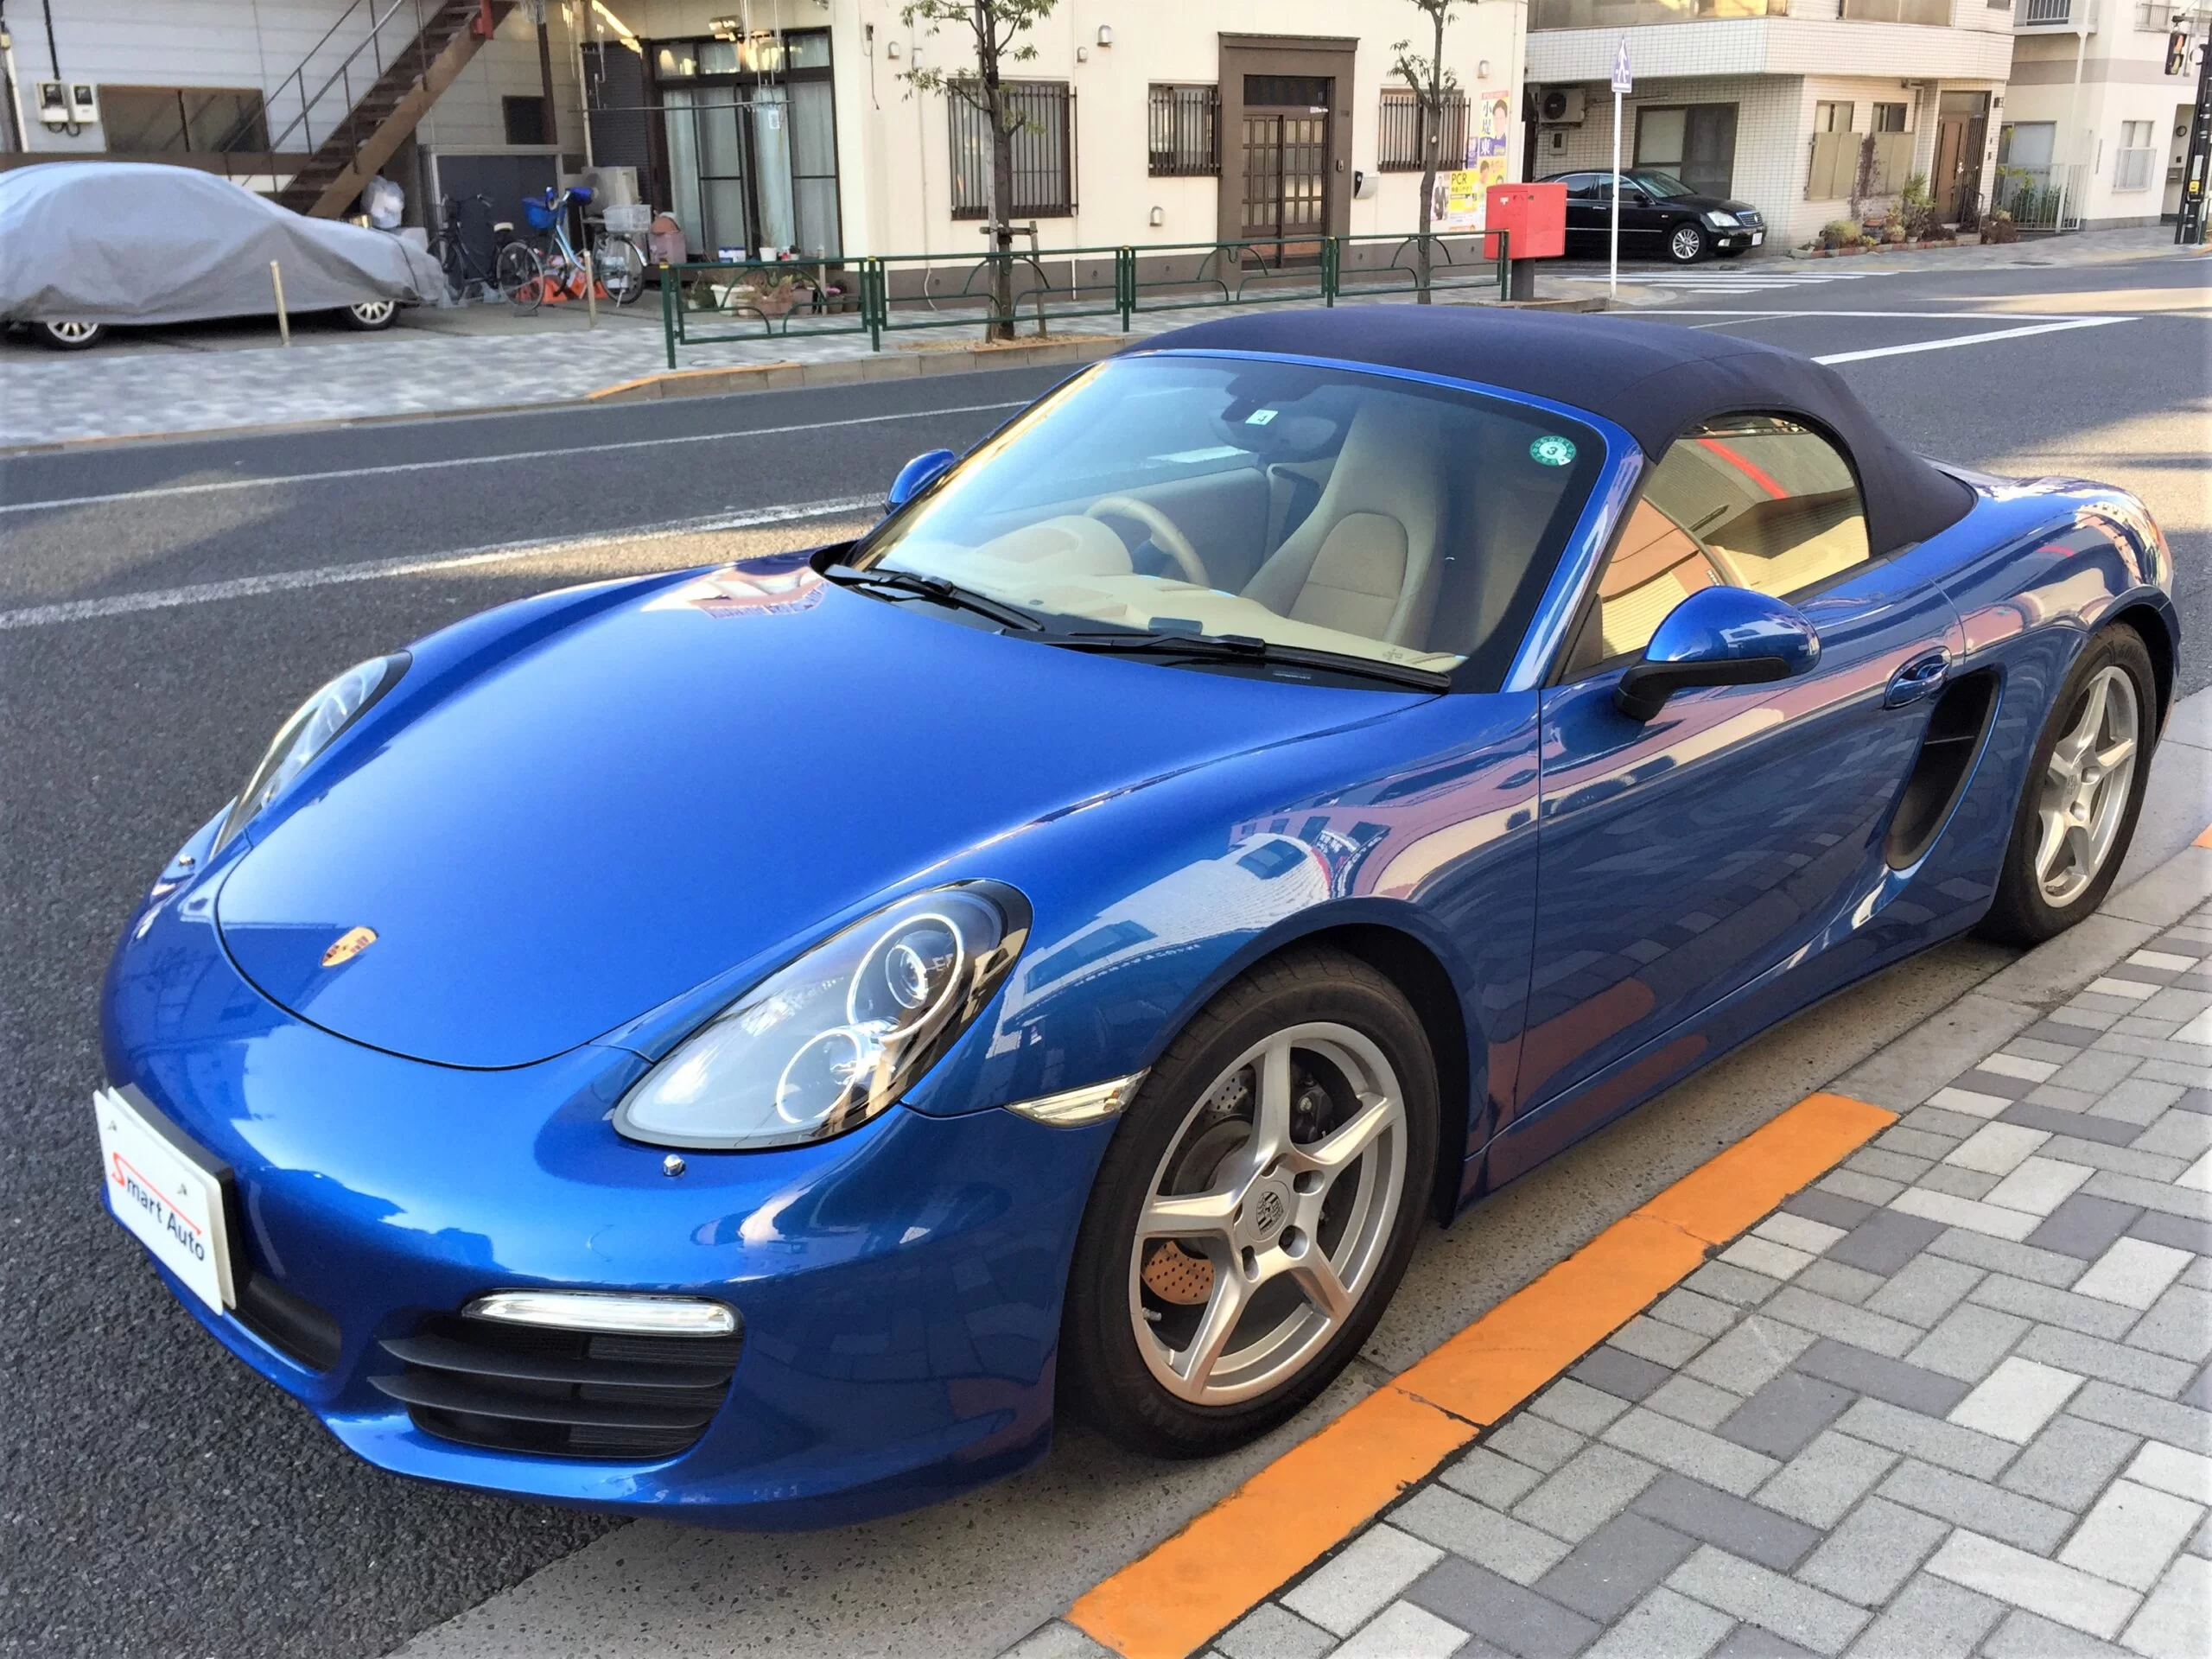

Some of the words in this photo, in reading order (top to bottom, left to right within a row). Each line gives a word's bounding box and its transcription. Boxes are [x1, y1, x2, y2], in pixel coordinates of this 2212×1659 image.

[1452, 173, 1467, 185] PCR
[1547, 446, 1559, 455] 3
[111, 1152, 162, 1224] Smart
[167, 1213, 206, 1262] Auto
